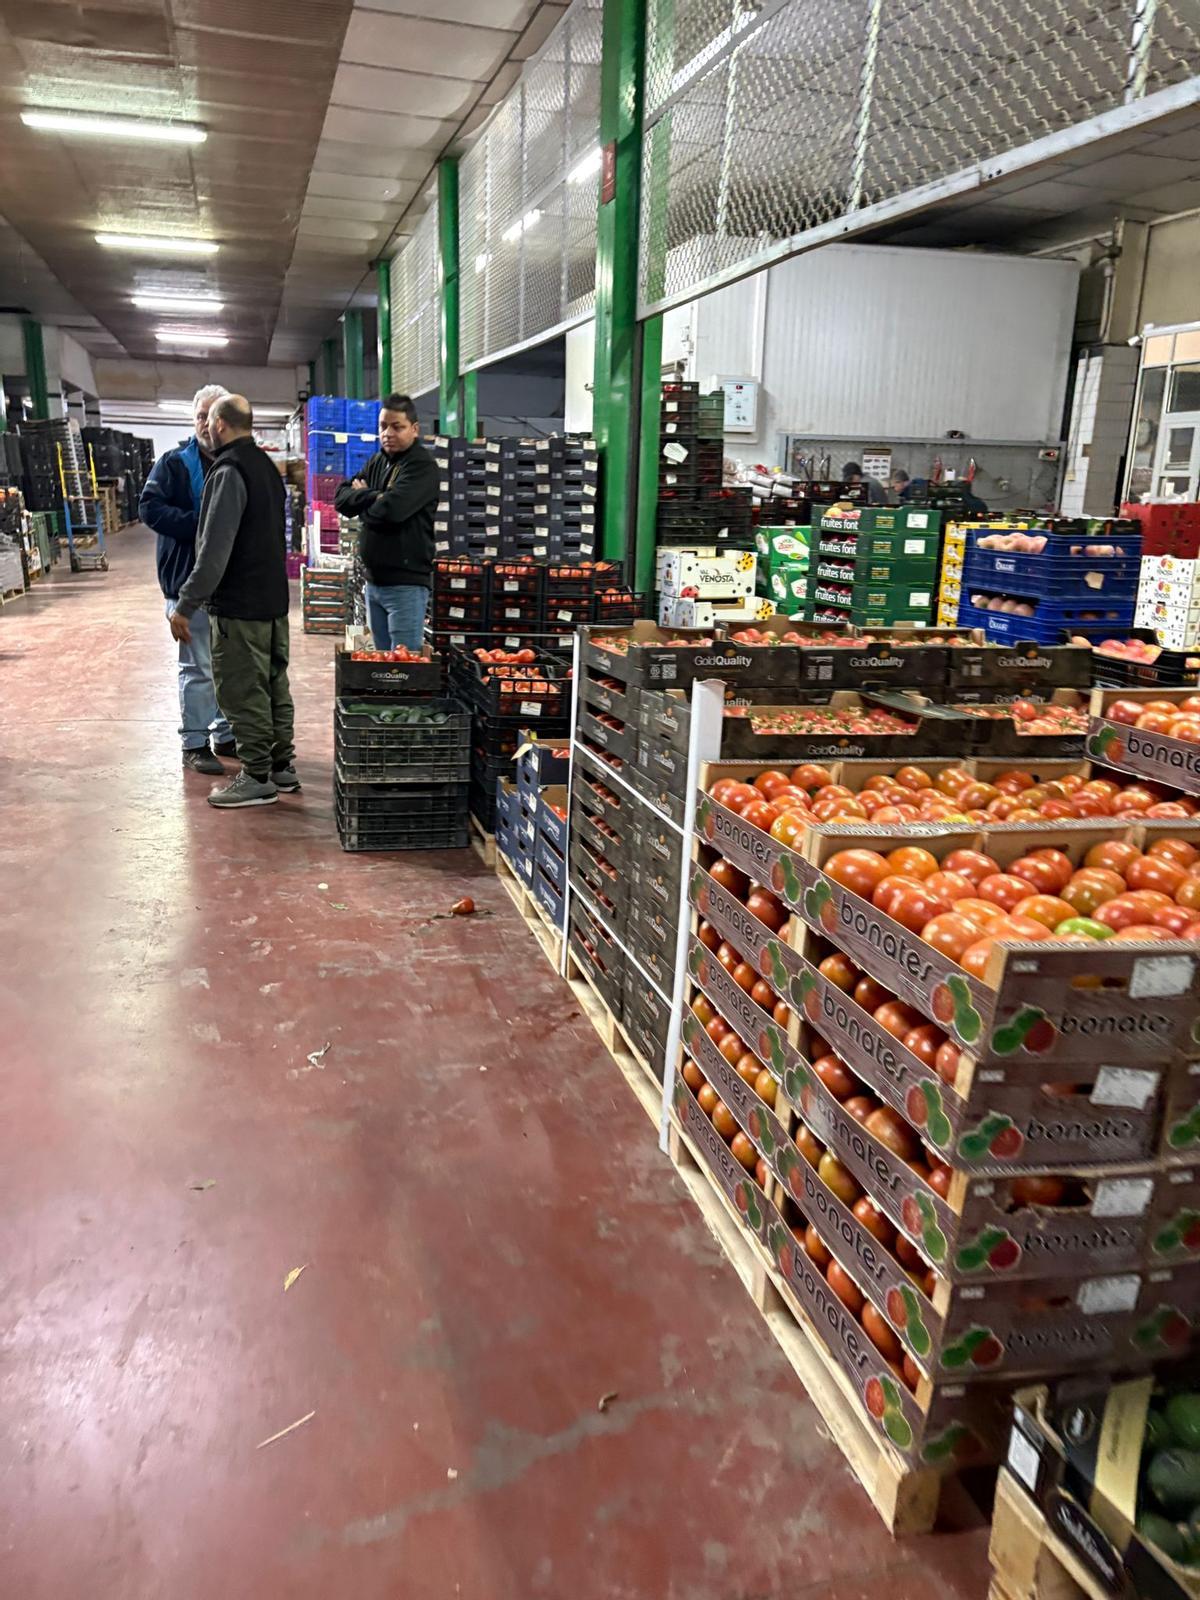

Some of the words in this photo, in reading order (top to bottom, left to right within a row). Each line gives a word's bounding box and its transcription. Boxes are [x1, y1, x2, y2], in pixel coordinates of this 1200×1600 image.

[821, 517, 842, 529] fruites
[844, 519, 858, 530] font
[819, 541, 840, 553] fruites
[842, 543, 857, 554] font
[700, 574, 734, 582] VENOSTA
[817, 565, 839, 578] fruites
[840, 568, 854, 580] font
[815, 589, 836, 602] fruites
[837, 592, 852, 606] font
[370, 672, 409, 680] GoldQuality
[694, 656, 752, 667] GoldQuality
[850, 657, 904, 668] GoldQuality
[998, 656, 1052, 668] GoldQuality
[808, 744, 865, 756] GoldQuality
[1128, 731, 1200, 774] bonate
[716, 814, 771, 863] bonates
[709, 887, 760, 947] bonates
[841, 893, 933, 980] bonates
[709, 964, 758, 1029] bonates
[824, 986, 908, 1082] bonates
[688, 1100, 734, 1178] bonates
[817, 1094, 901, 1190] bonates
[804, 1168, 888, 1280] bonates
[794, 1245, 870, 1369] bonates
